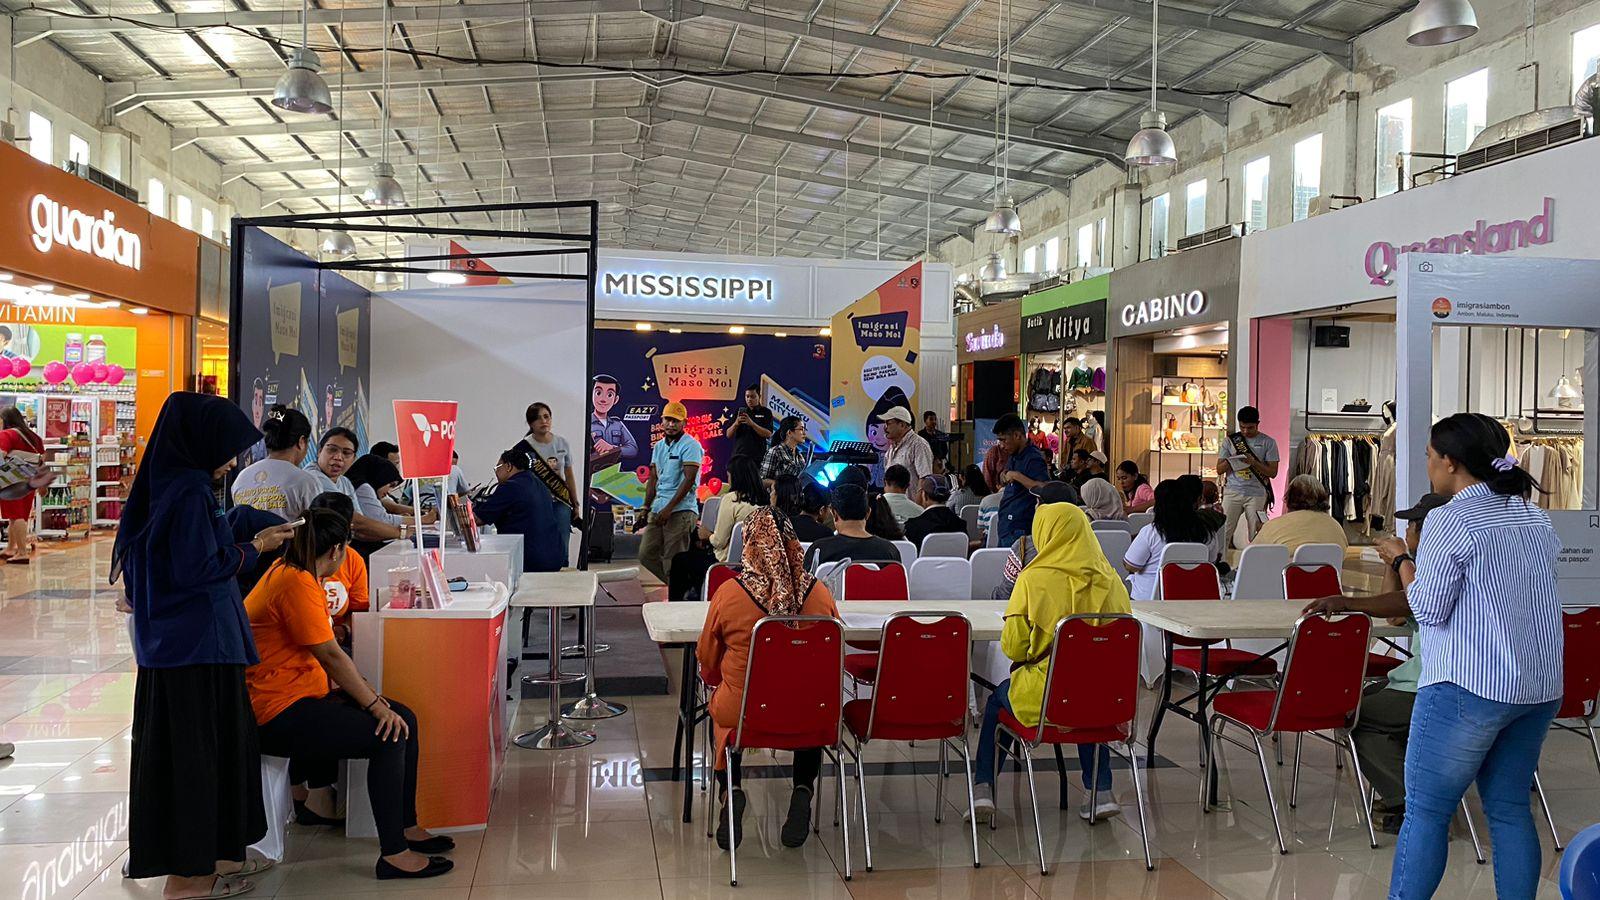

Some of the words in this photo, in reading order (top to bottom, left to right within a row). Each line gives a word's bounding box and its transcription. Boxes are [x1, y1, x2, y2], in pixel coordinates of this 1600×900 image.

[31, 193, 141, 271] guardian
[605, 273, 772, 300] MISSISSIPPI
[1121, 289, 1204, 327] GABINO
[1456, 301, 1511, 311] imigrasiambon
[858, 321, 898, 332] Imigrasi
[1047, 316, 1091, 341] Aditya
[861, 330, 883, 338] Maso
[885, 330, 901, 339] Mol
[664, 364, 729, 378] Imigrasi
[668, 377, 704, 387] Maso
[709, 378, 733, 388] Mol
[629, 406, 655, 414] EAZY
[769, 400, 786, 416] CITY
[771, 394, 810, 423] MALUKU
